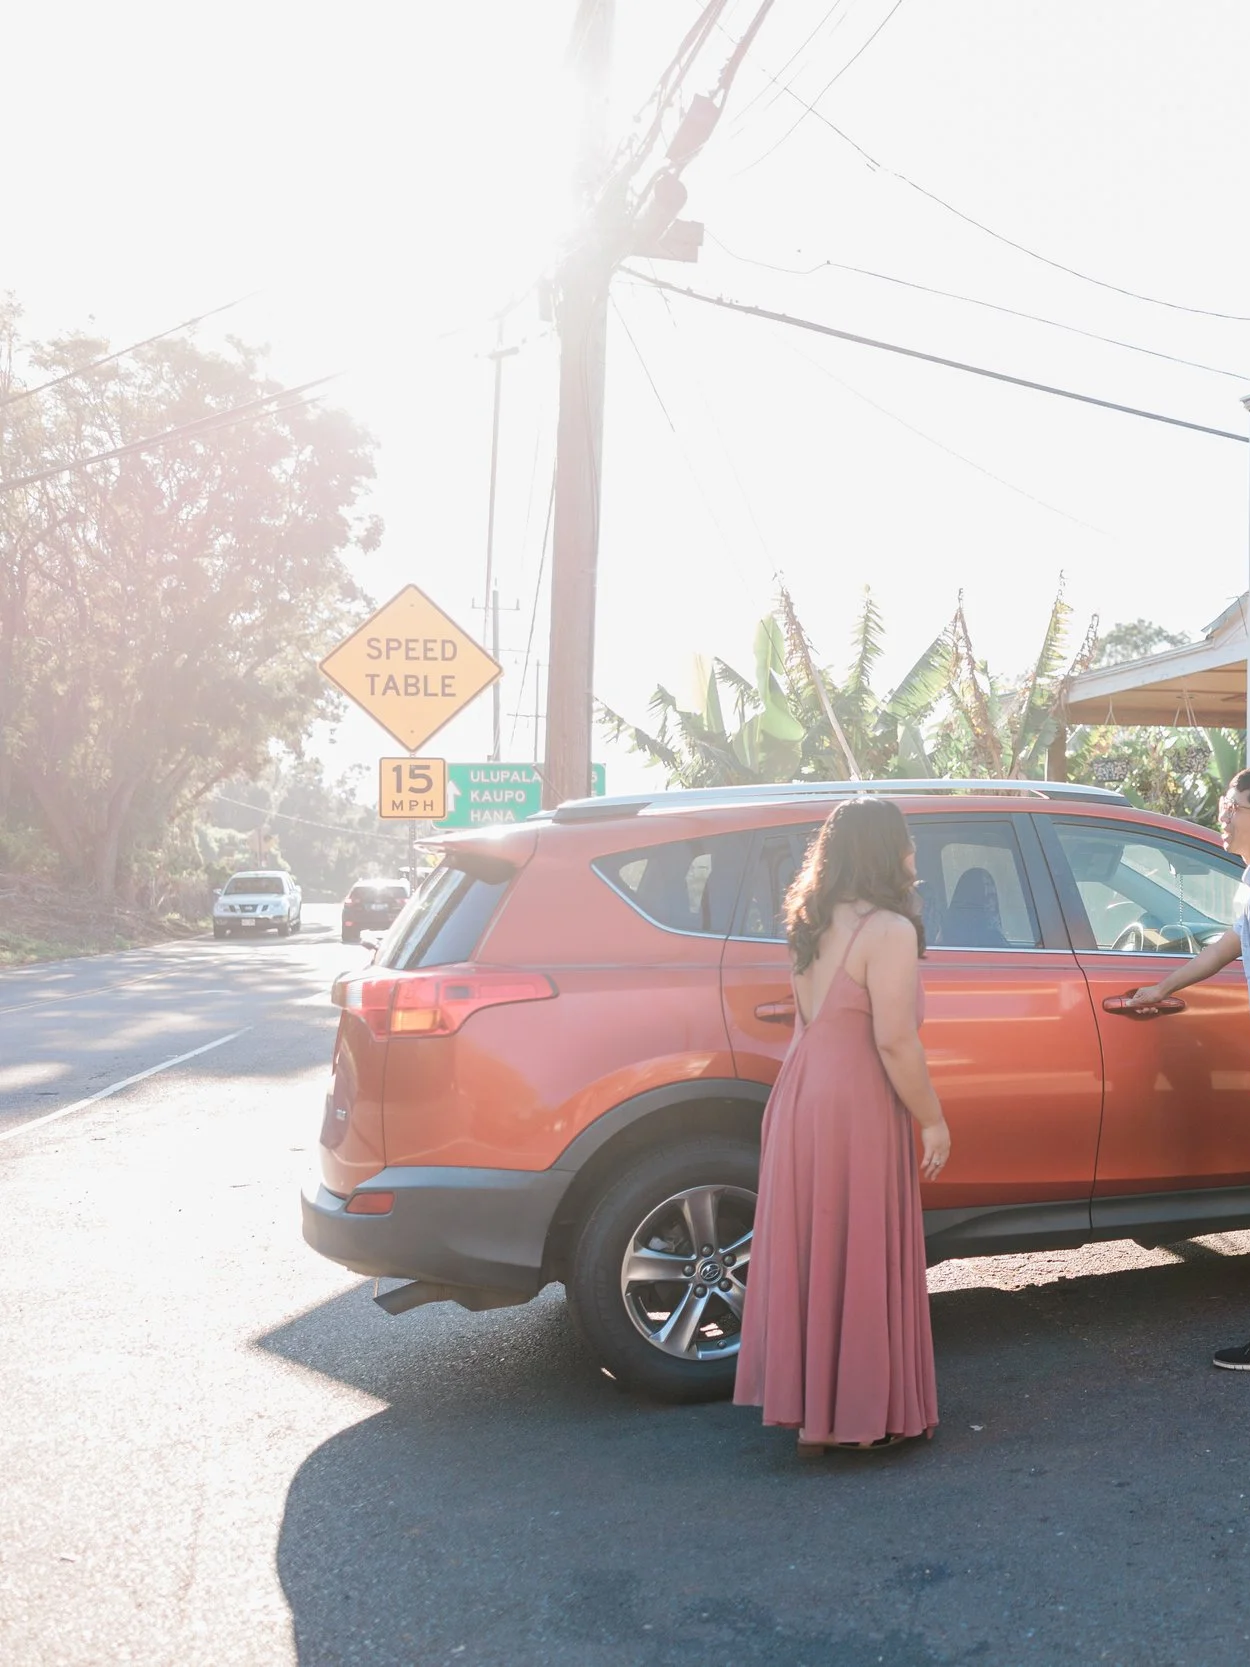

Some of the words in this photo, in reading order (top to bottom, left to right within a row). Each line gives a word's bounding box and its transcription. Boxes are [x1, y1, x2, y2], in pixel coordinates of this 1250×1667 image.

[365, 637, 458, 662] SPEED
[365, 673, 457, 697] TABLE
[391, 764, 433, 794] 15
[470, 770, 542, 783] ULUPALA
[470, 790, 526, 803] KAUPO
[391, 799, 434, 812] MPH
[470, 809, 516, 823] HANA
